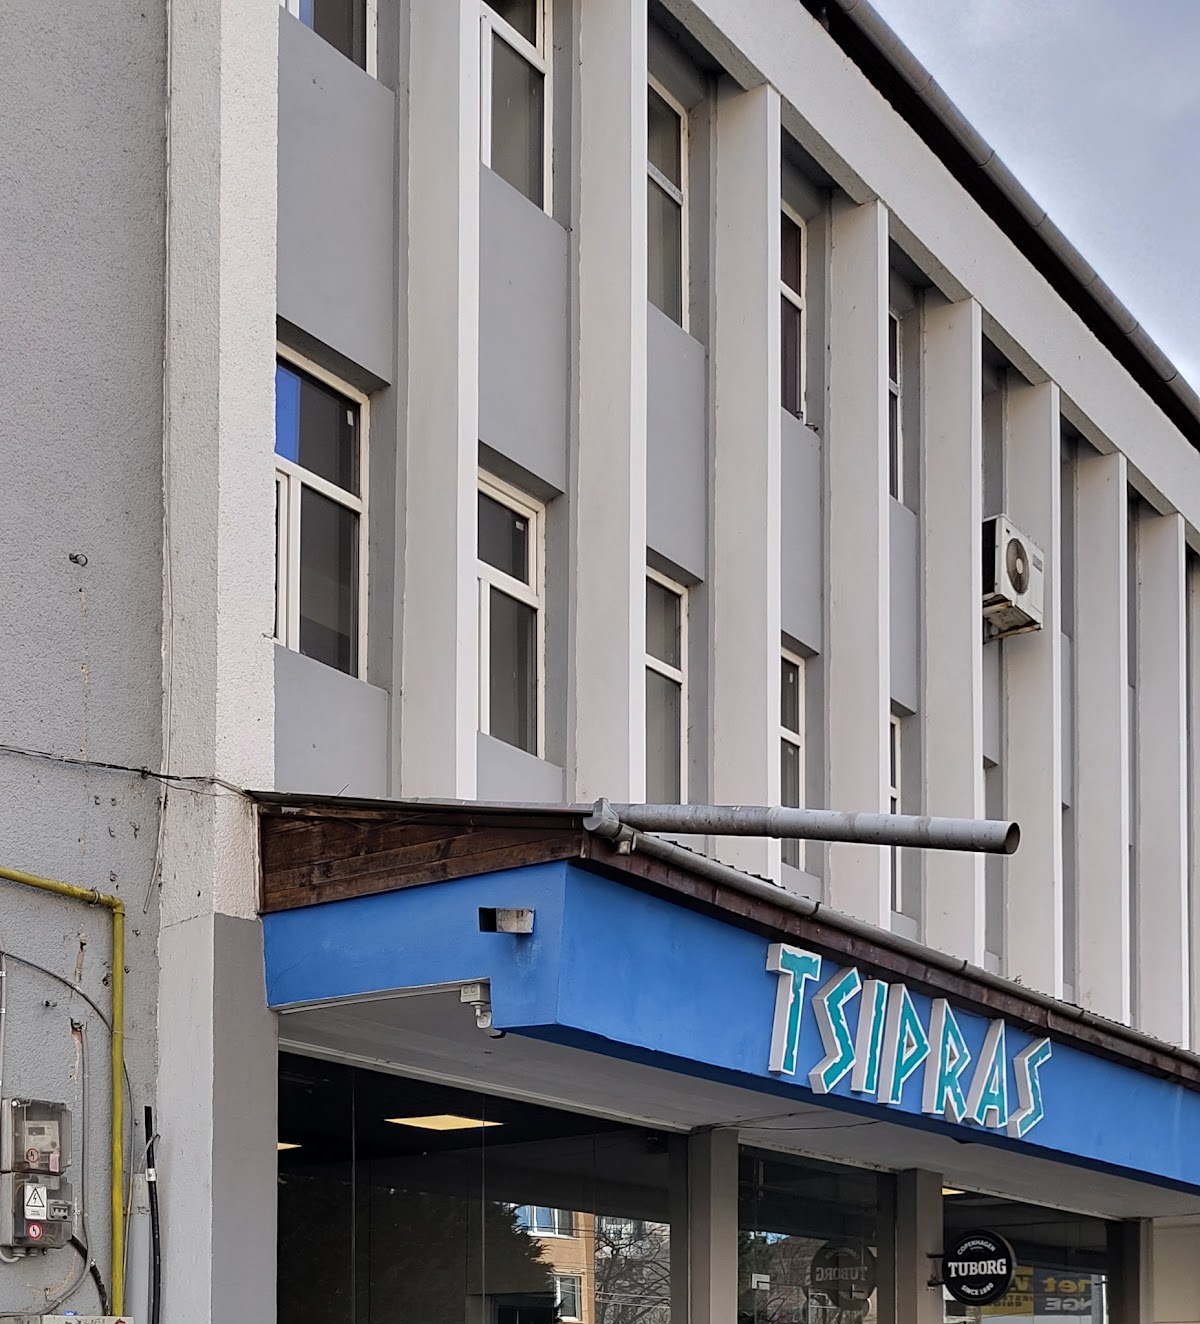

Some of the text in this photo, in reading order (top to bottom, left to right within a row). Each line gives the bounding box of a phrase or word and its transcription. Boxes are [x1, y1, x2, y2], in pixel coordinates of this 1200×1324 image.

[766, 943, 1052, 1138] TSIPRAS
[957, 1240, 996, 1255] COPENHAGEN
[948, 1258, 1007, 1277] TUBORG
[961, 1285, 979, 1295] SINCE
